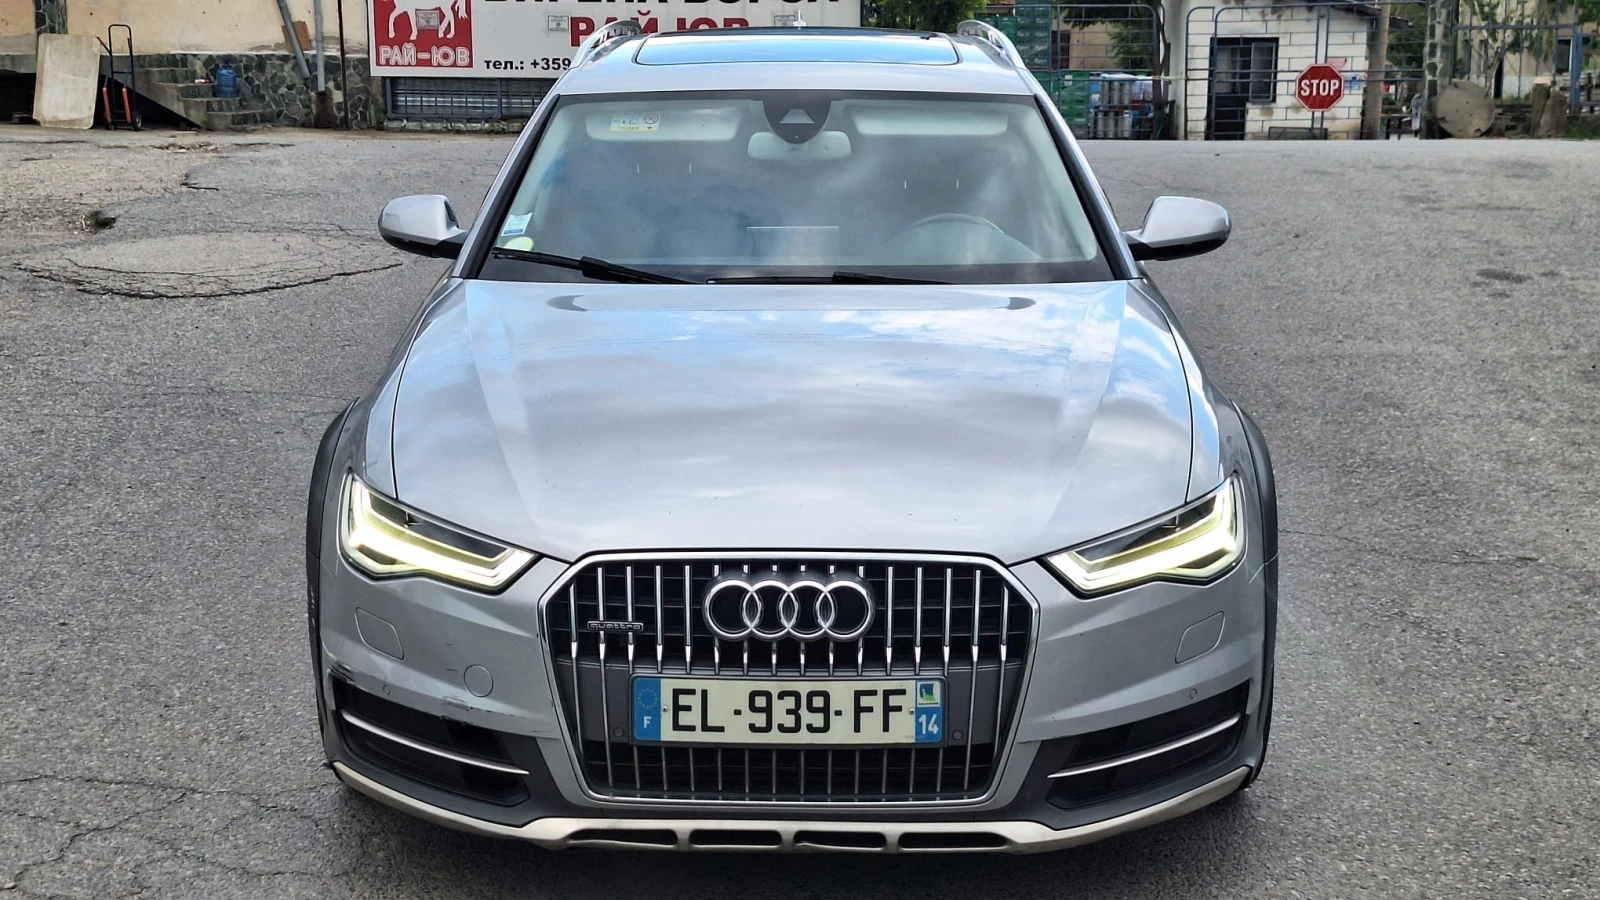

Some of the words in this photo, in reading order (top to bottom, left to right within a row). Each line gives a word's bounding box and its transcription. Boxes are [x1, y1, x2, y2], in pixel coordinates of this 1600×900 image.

[379, 43, 470, 66] РАЙ-ЮВ
[484, 59, 525, 70] тел.:
[1300, 79, 1339, 96] STOP
[643, 716, 652, 729] F
[918, 714, 939, 735] 14
